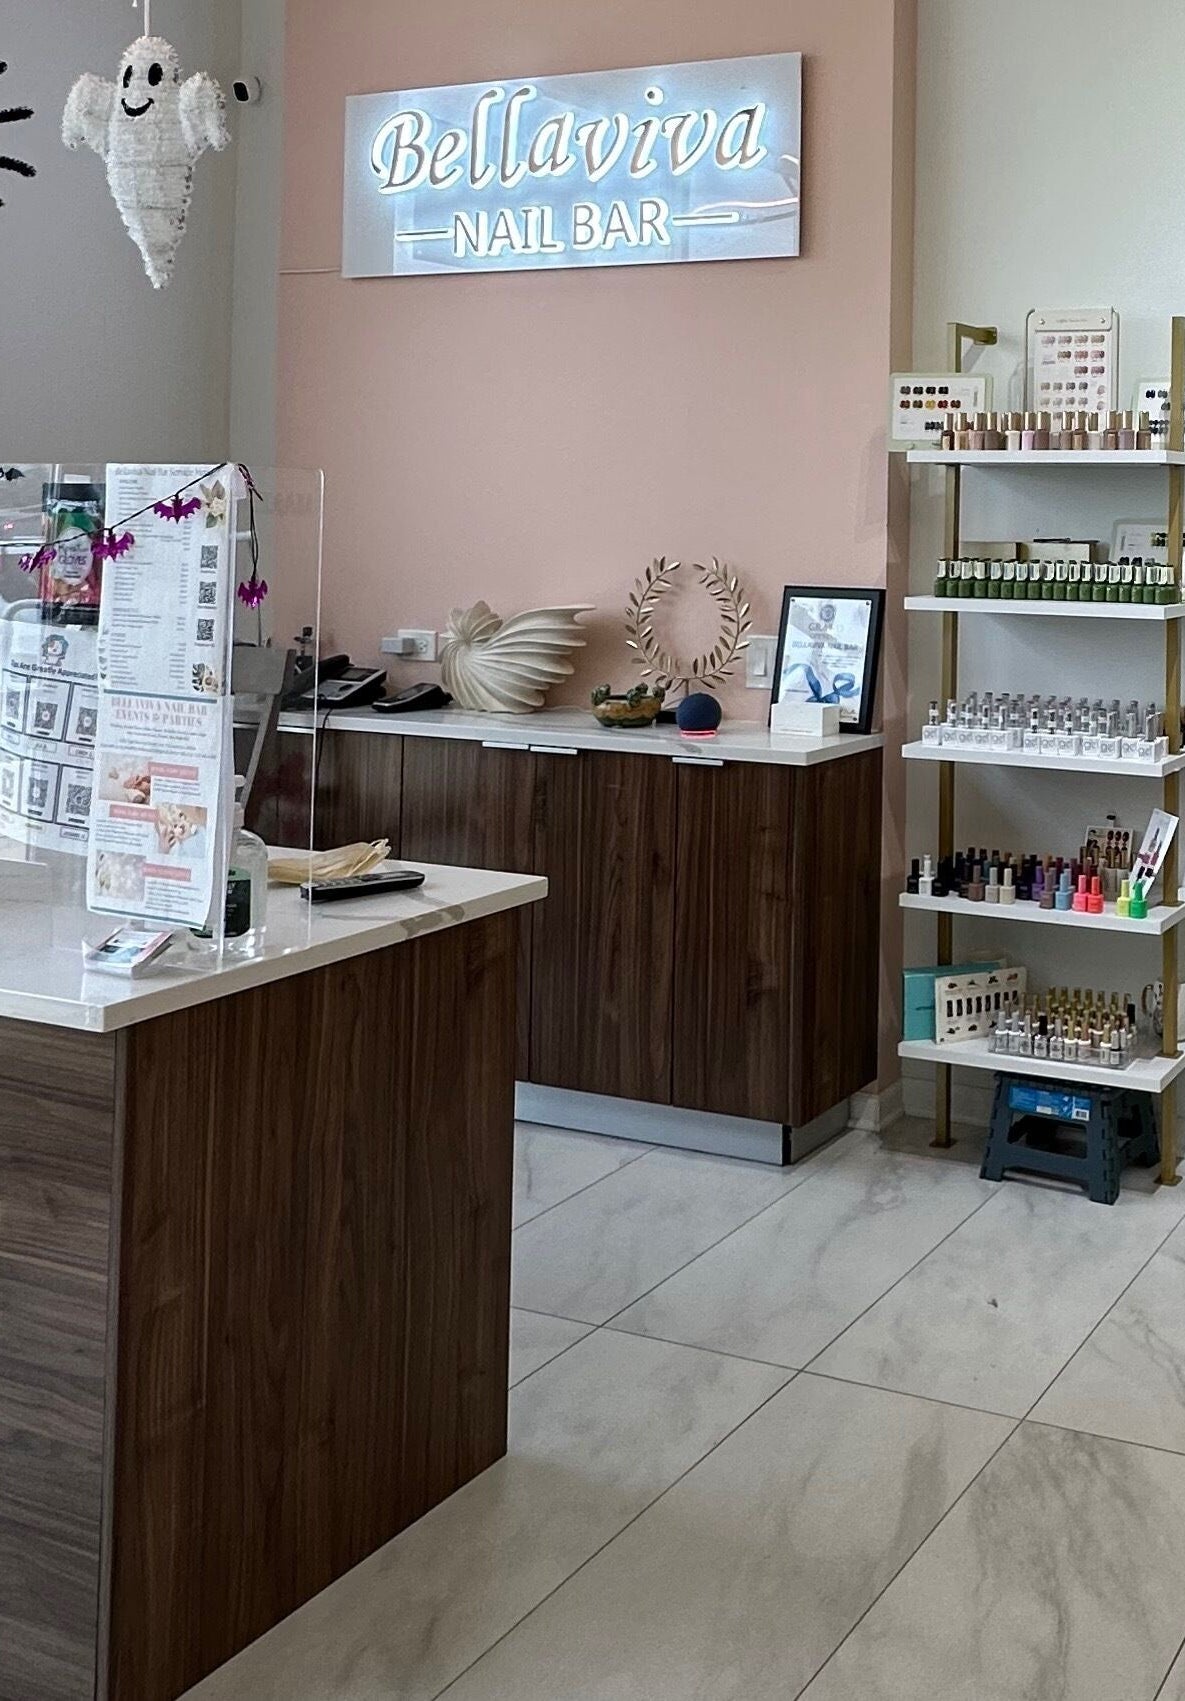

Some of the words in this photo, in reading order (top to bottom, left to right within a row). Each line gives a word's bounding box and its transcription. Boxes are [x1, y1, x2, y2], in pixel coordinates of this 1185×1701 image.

[371, 85, 767, 195] Bellaviva
[452, 201, 565, 258] NAIL
[571, 198, 671, 251] BAR
